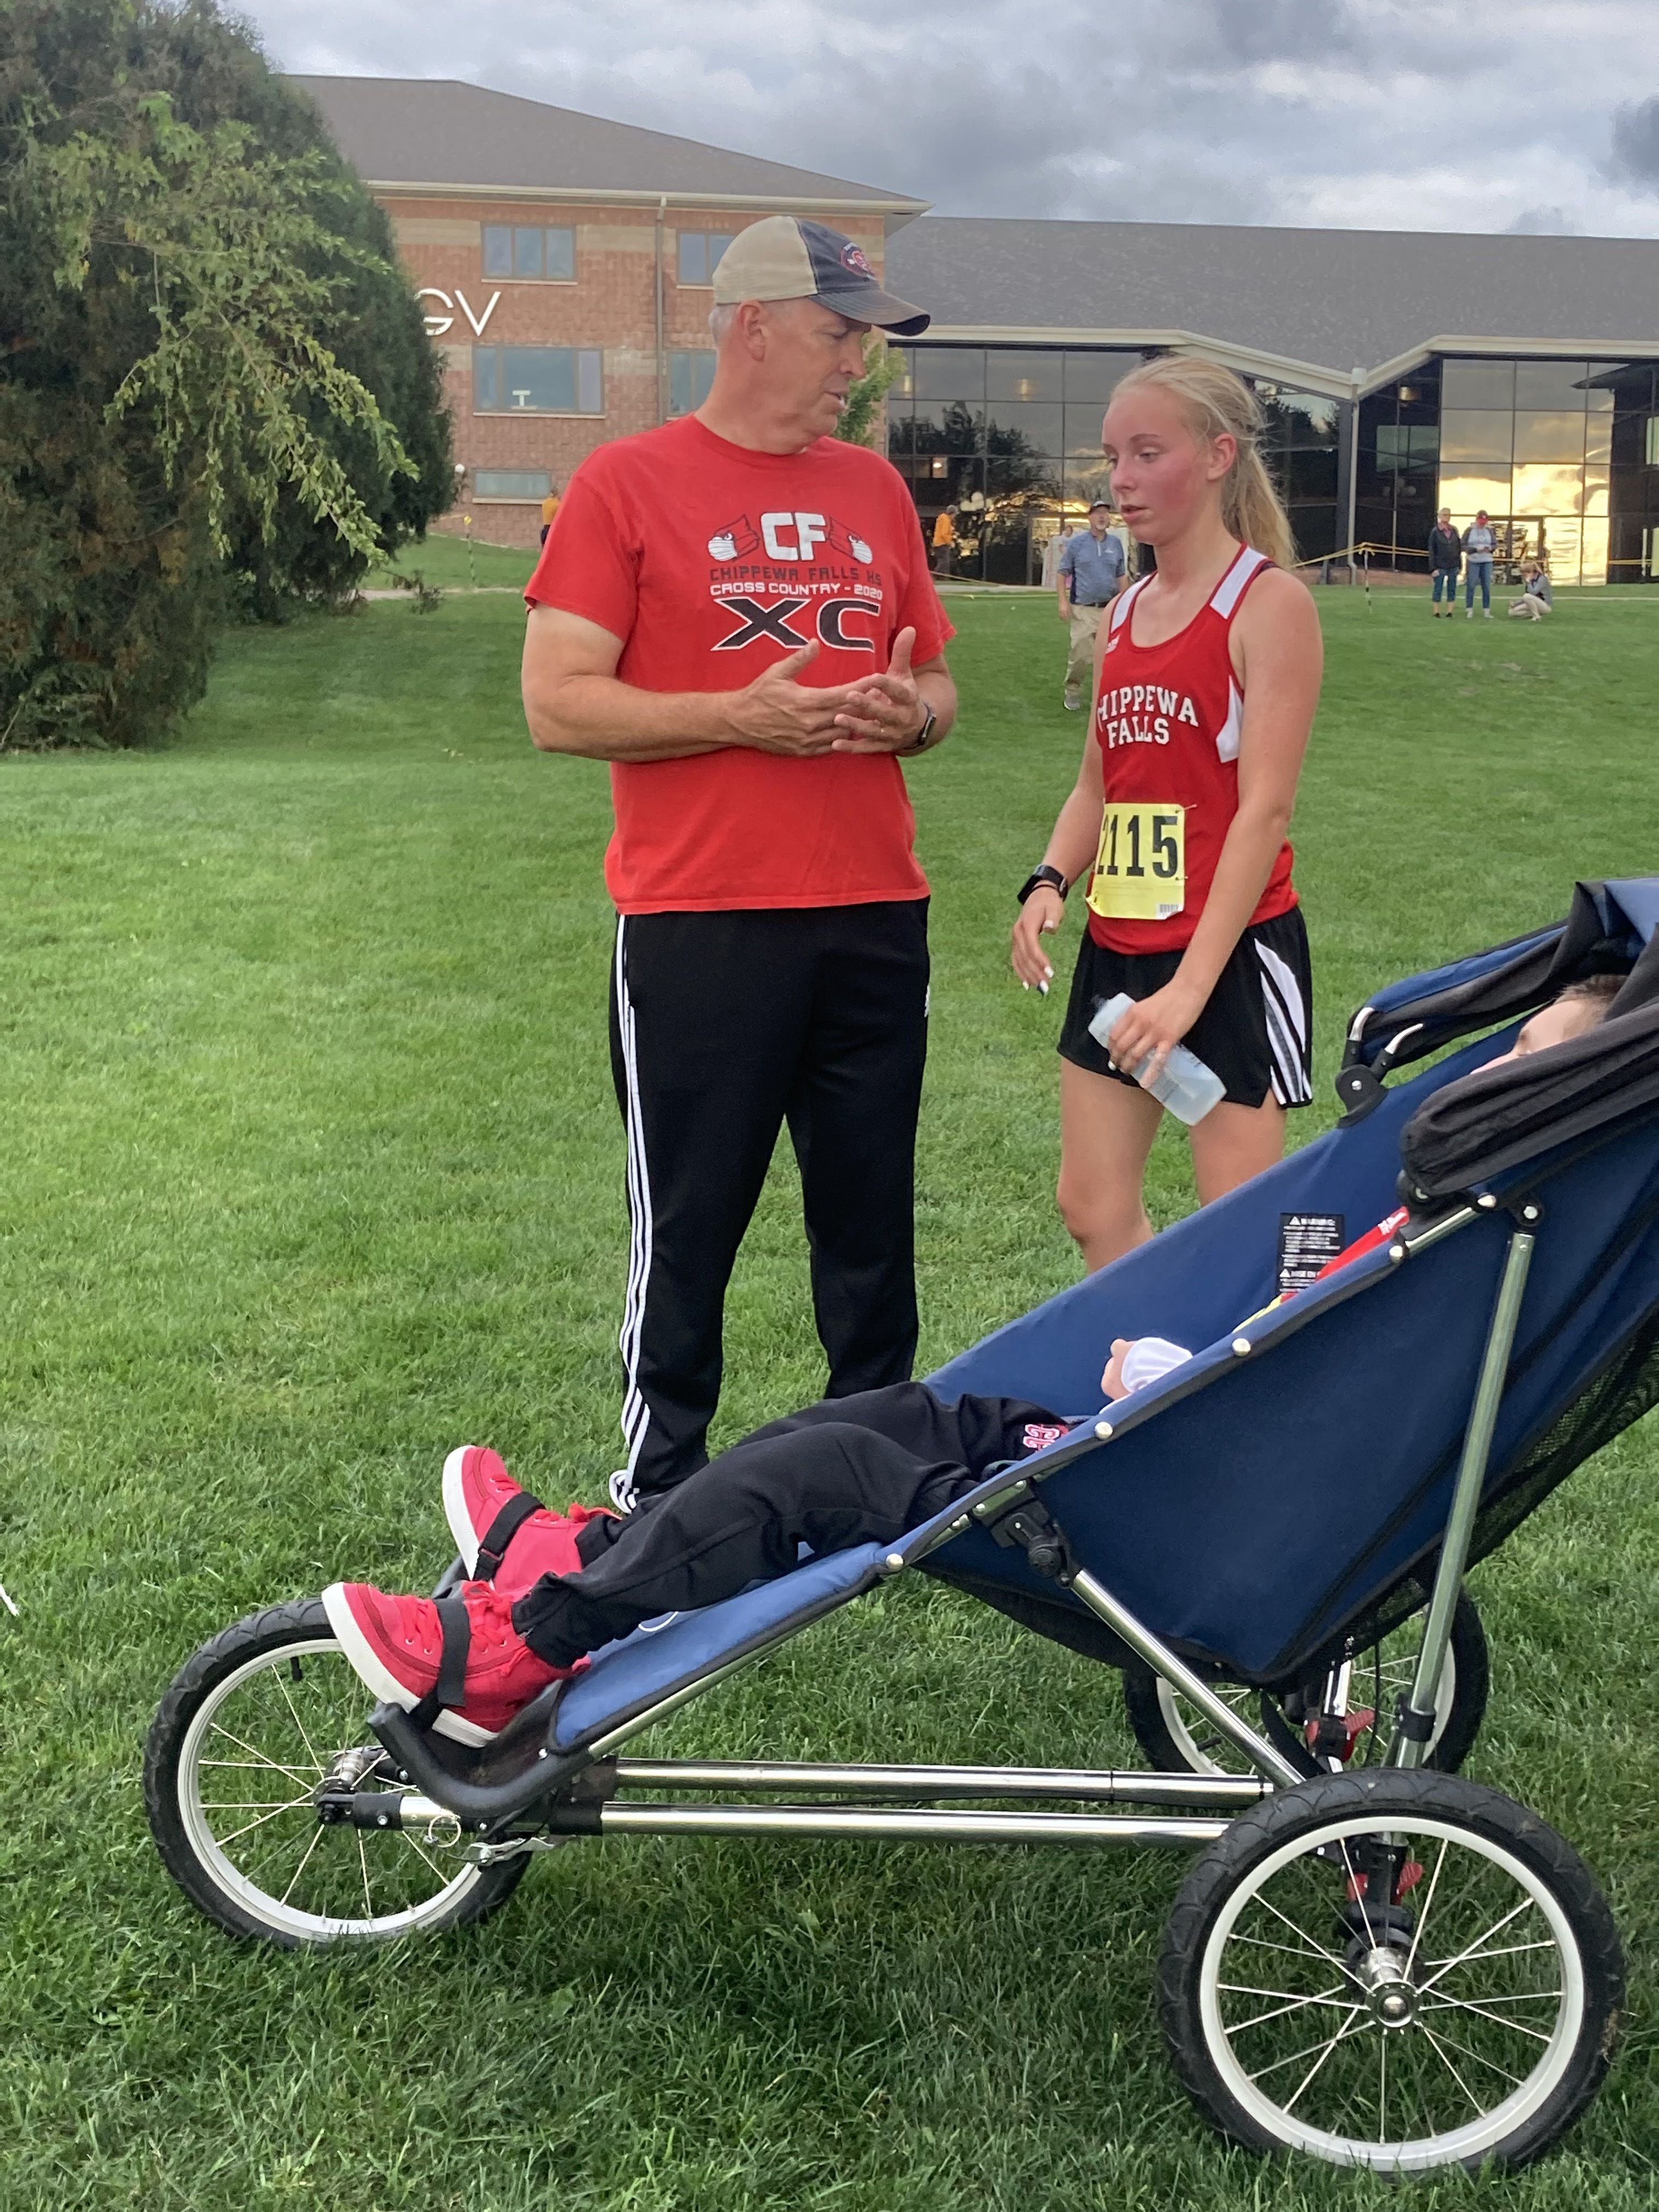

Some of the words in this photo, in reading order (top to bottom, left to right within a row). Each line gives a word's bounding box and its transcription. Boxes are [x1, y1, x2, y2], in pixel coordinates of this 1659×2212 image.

[760, 512, 826, 561] CF
[710, 566, 799, 581] CHIPPEWA
[809, 566, 859, 580] FALLS
[710, 582, 765, 595] CROSS
[769, 583, 840, 595] COUNTRY
[854, 584, 883, 600] 2020
[710, 596, 881, 653] XC
[1097, 685, 1199, 732] HIPPEWA
[1107, 716, 1170, 749] FALLS
